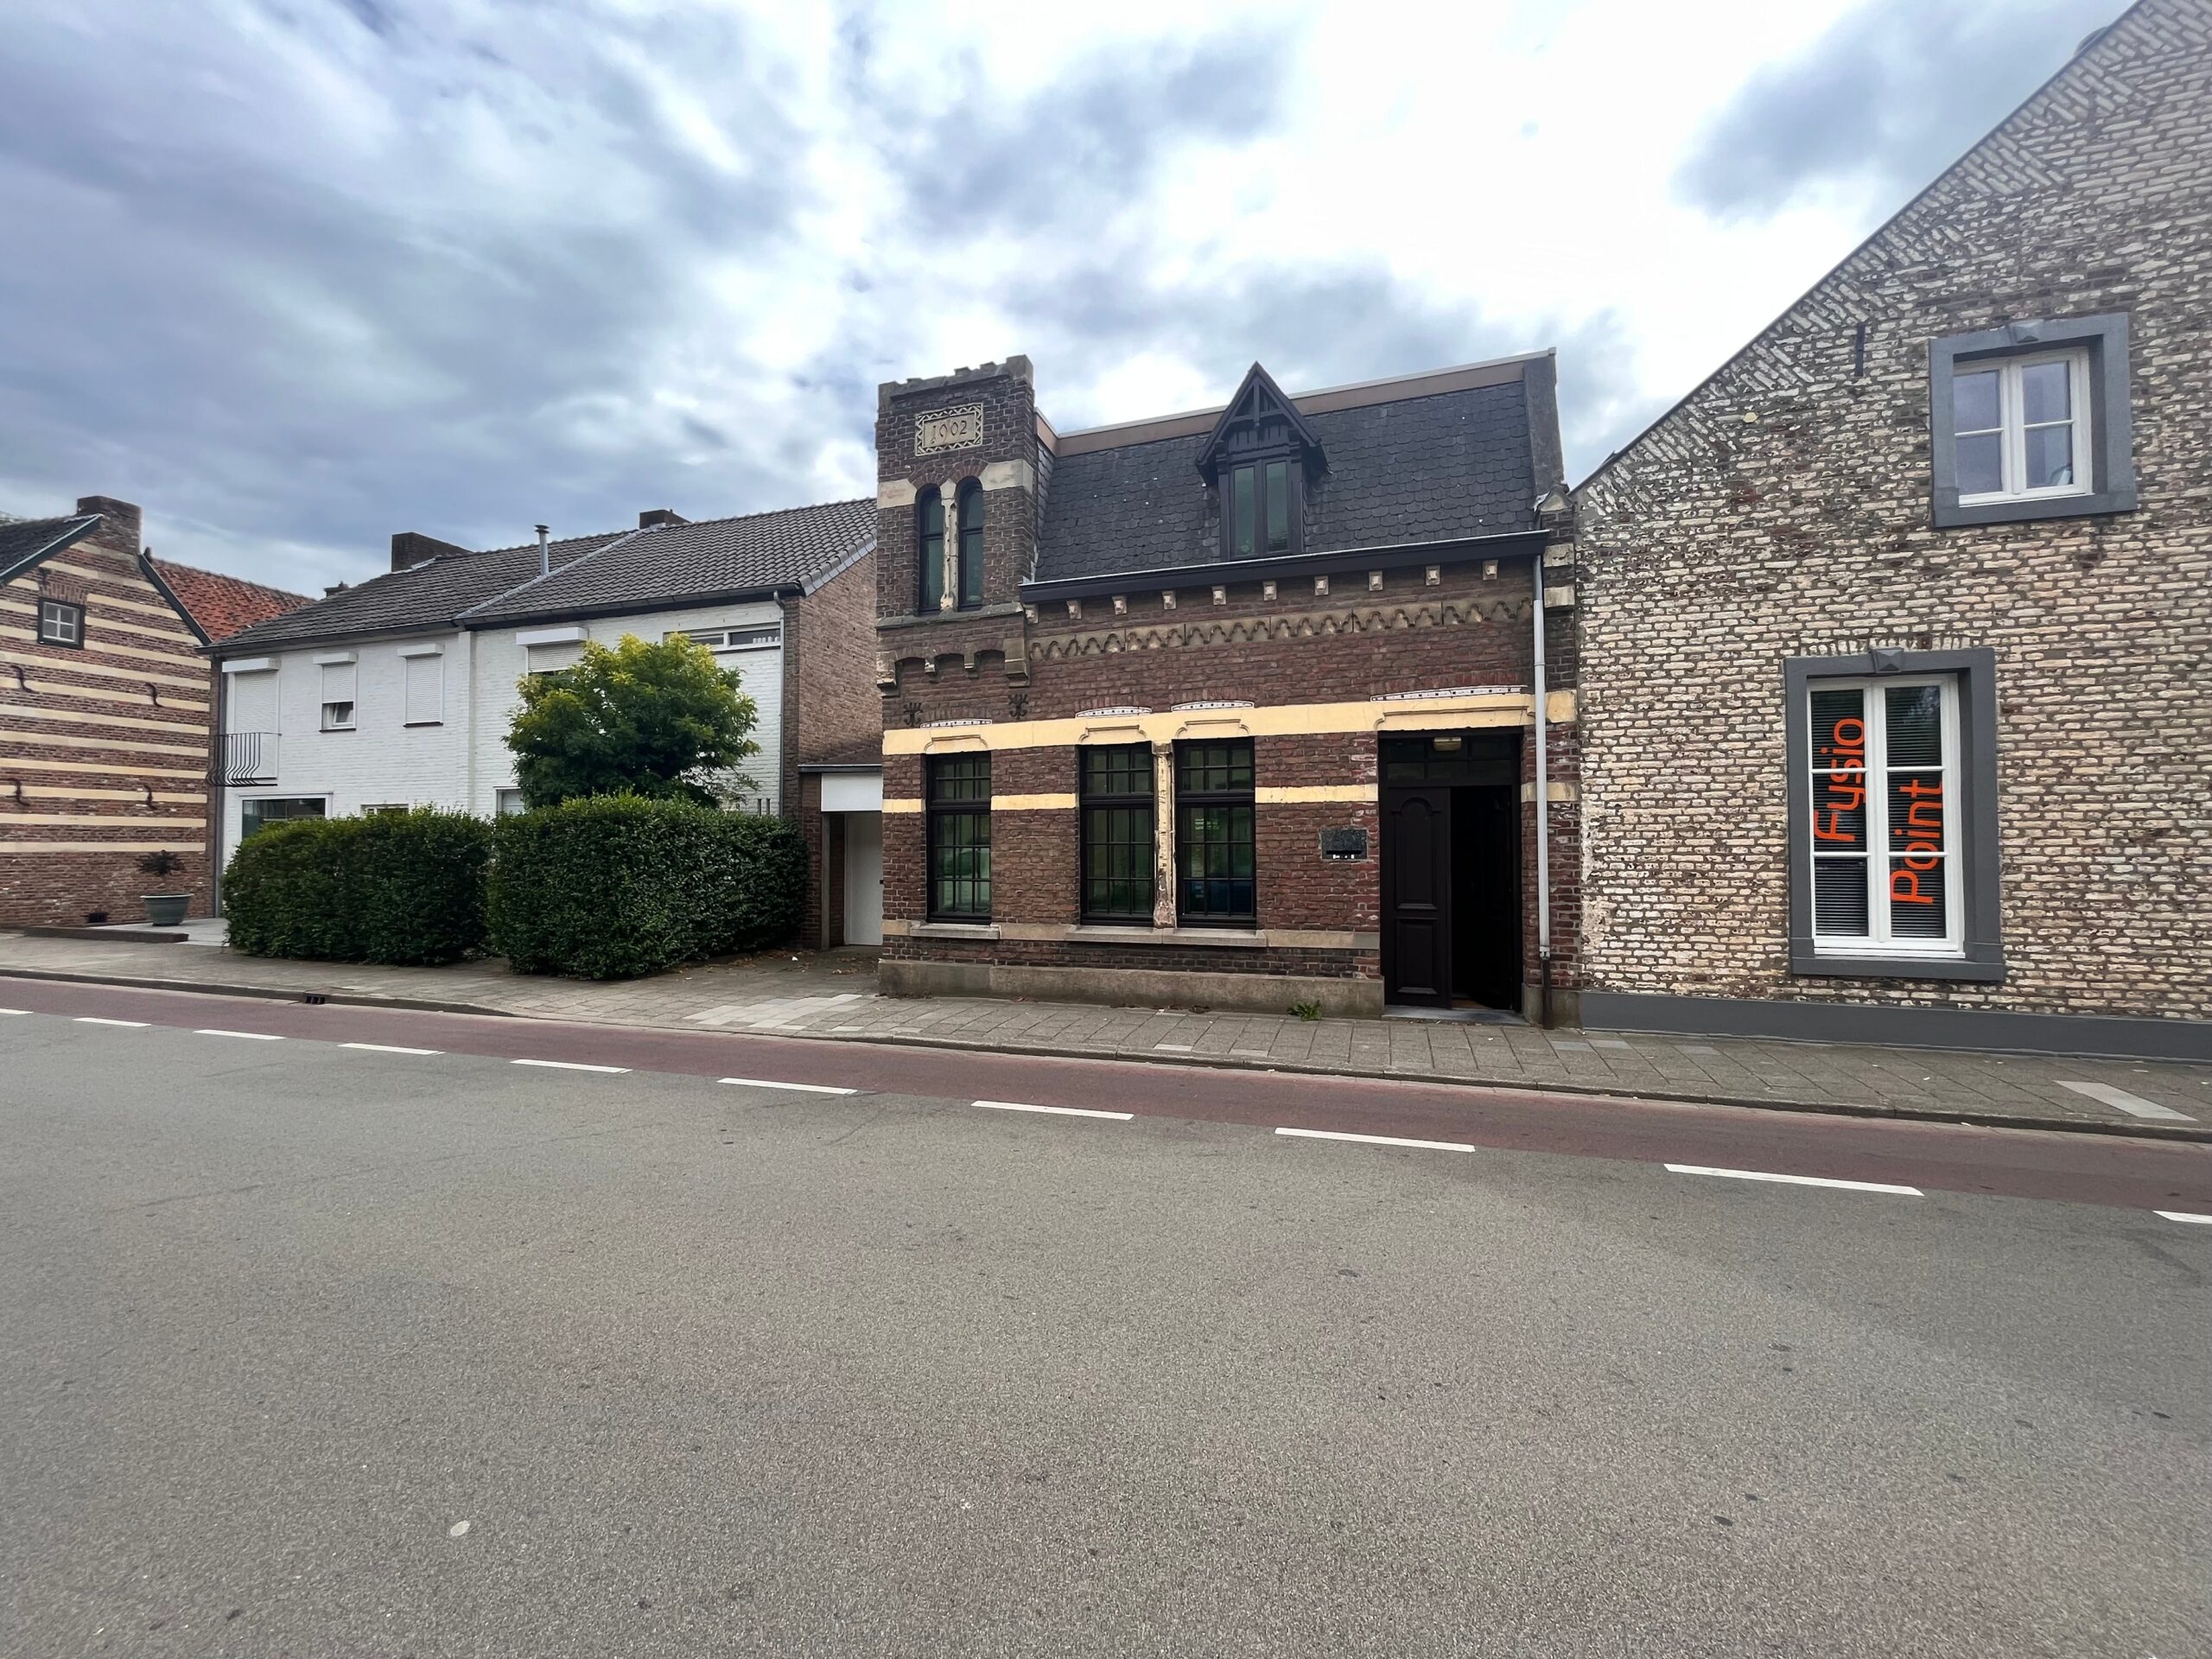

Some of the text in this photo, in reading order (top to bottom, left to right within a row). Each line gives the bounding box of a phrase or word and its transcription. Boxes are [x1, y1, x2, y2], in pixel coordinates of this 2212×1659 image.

[930, 420, 968, 444] 1902
[1814, 718, 1866, 842] Fysio
[1891, 779, 1943, 904] Point
